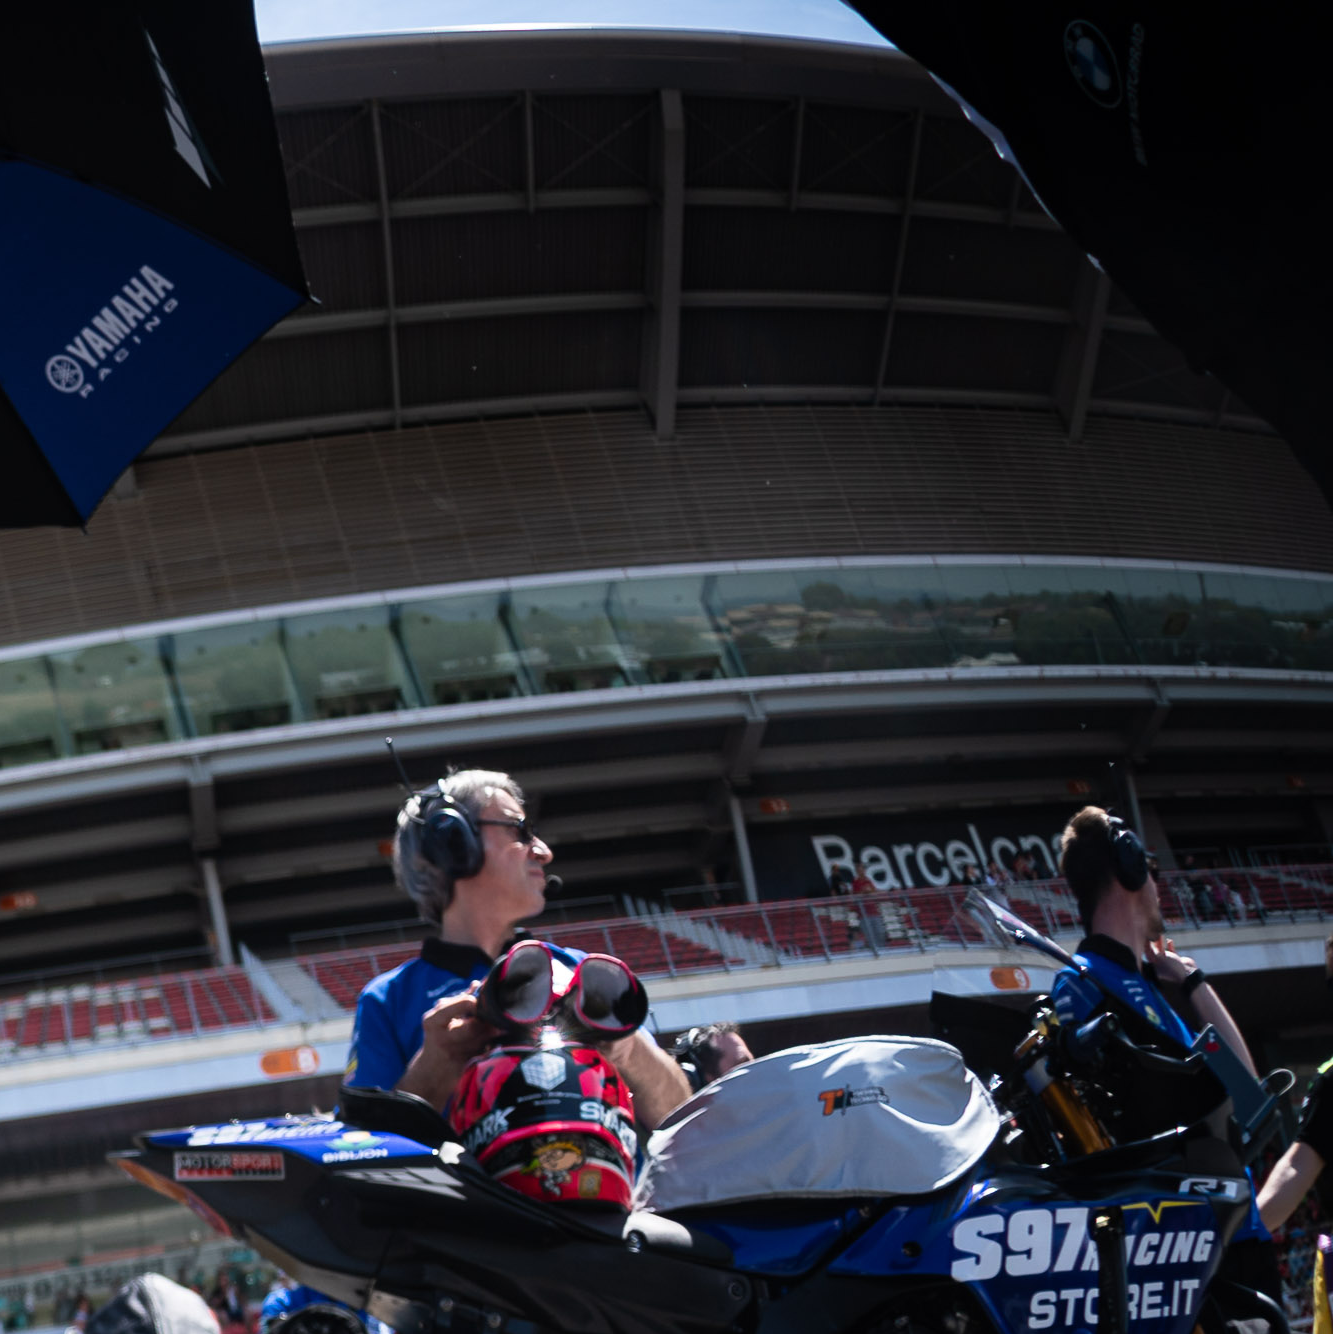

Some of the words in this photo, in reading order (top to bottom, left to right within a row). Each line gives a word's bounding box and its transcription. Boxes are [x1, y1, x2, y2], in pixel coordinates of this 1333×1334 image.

[39, 264, 173, 368] YAMAHA
[80, 297, 178, 399] RACING
[812, 823, 1070, 893] Barcelon
[951, 1207, 1090, 1283] S97
[1080, 1230, 1216, 1272] RCING
